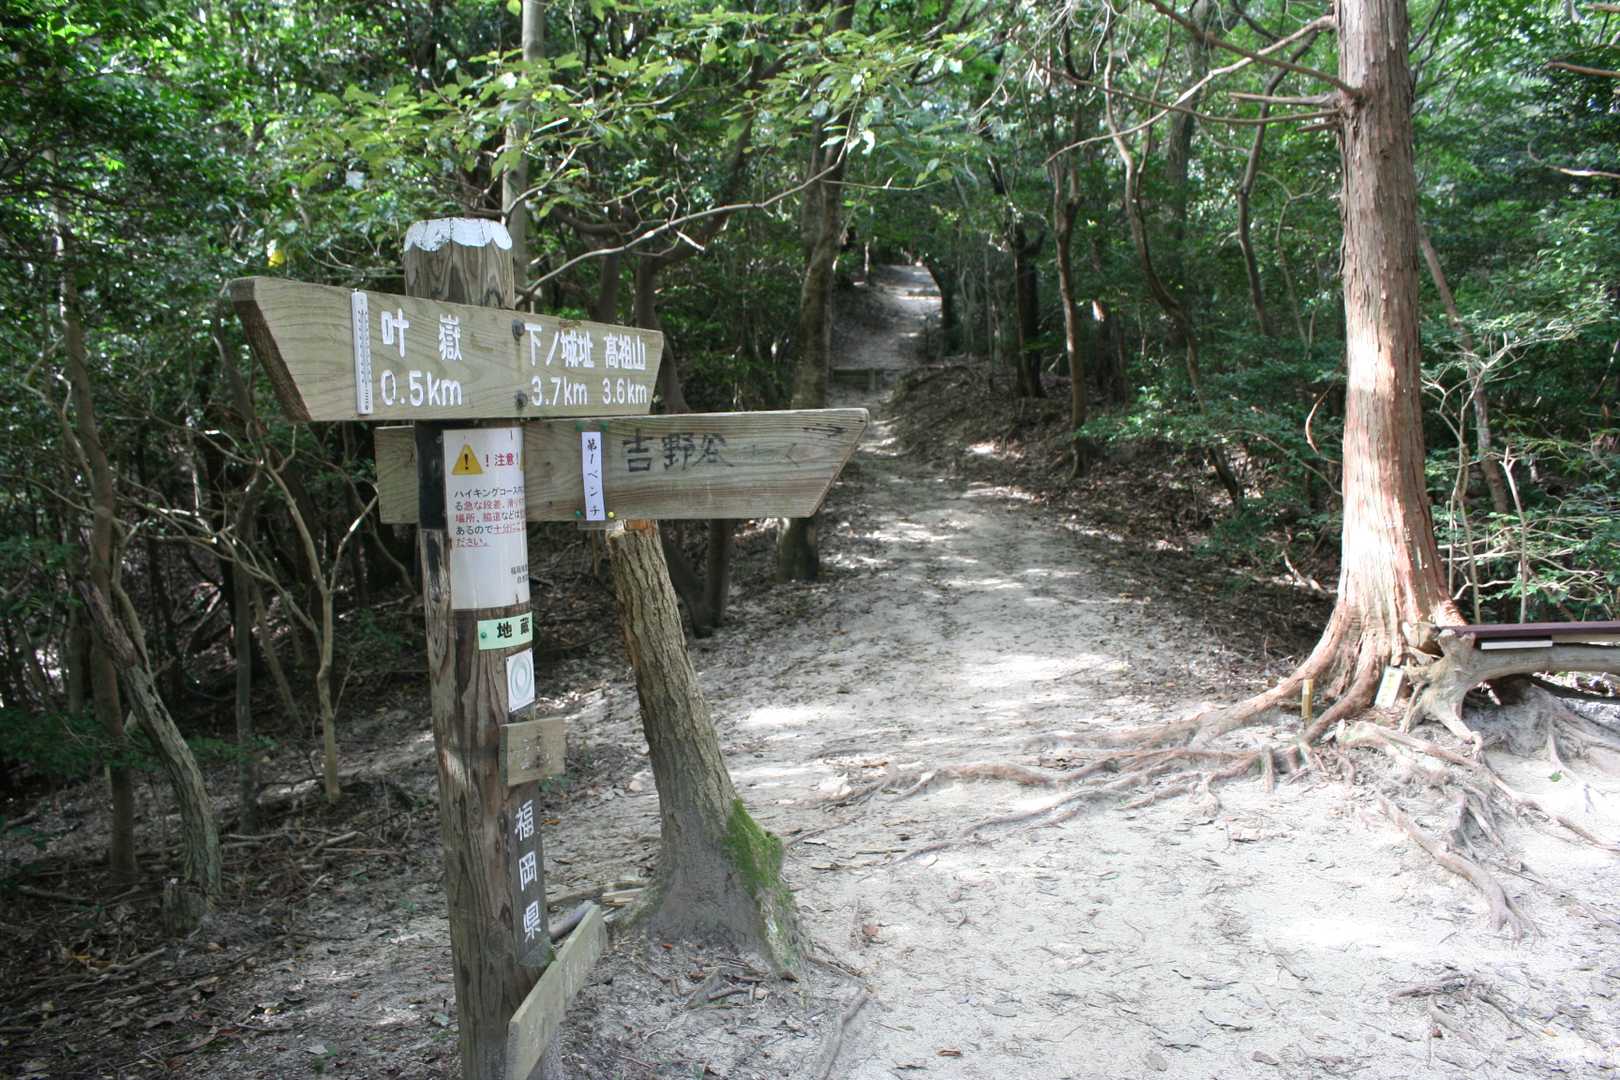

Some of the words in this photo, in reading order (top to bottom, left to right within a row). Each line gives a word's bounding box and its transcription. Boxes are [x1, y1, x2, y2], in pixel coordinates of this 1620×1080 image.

[381, 369, 462, 407] 0.5km
[531, 375, 588, 407] 3.7km
[602, 377, 647, 405] 3.6km
[514, 800, 542, 943] 福岡県
